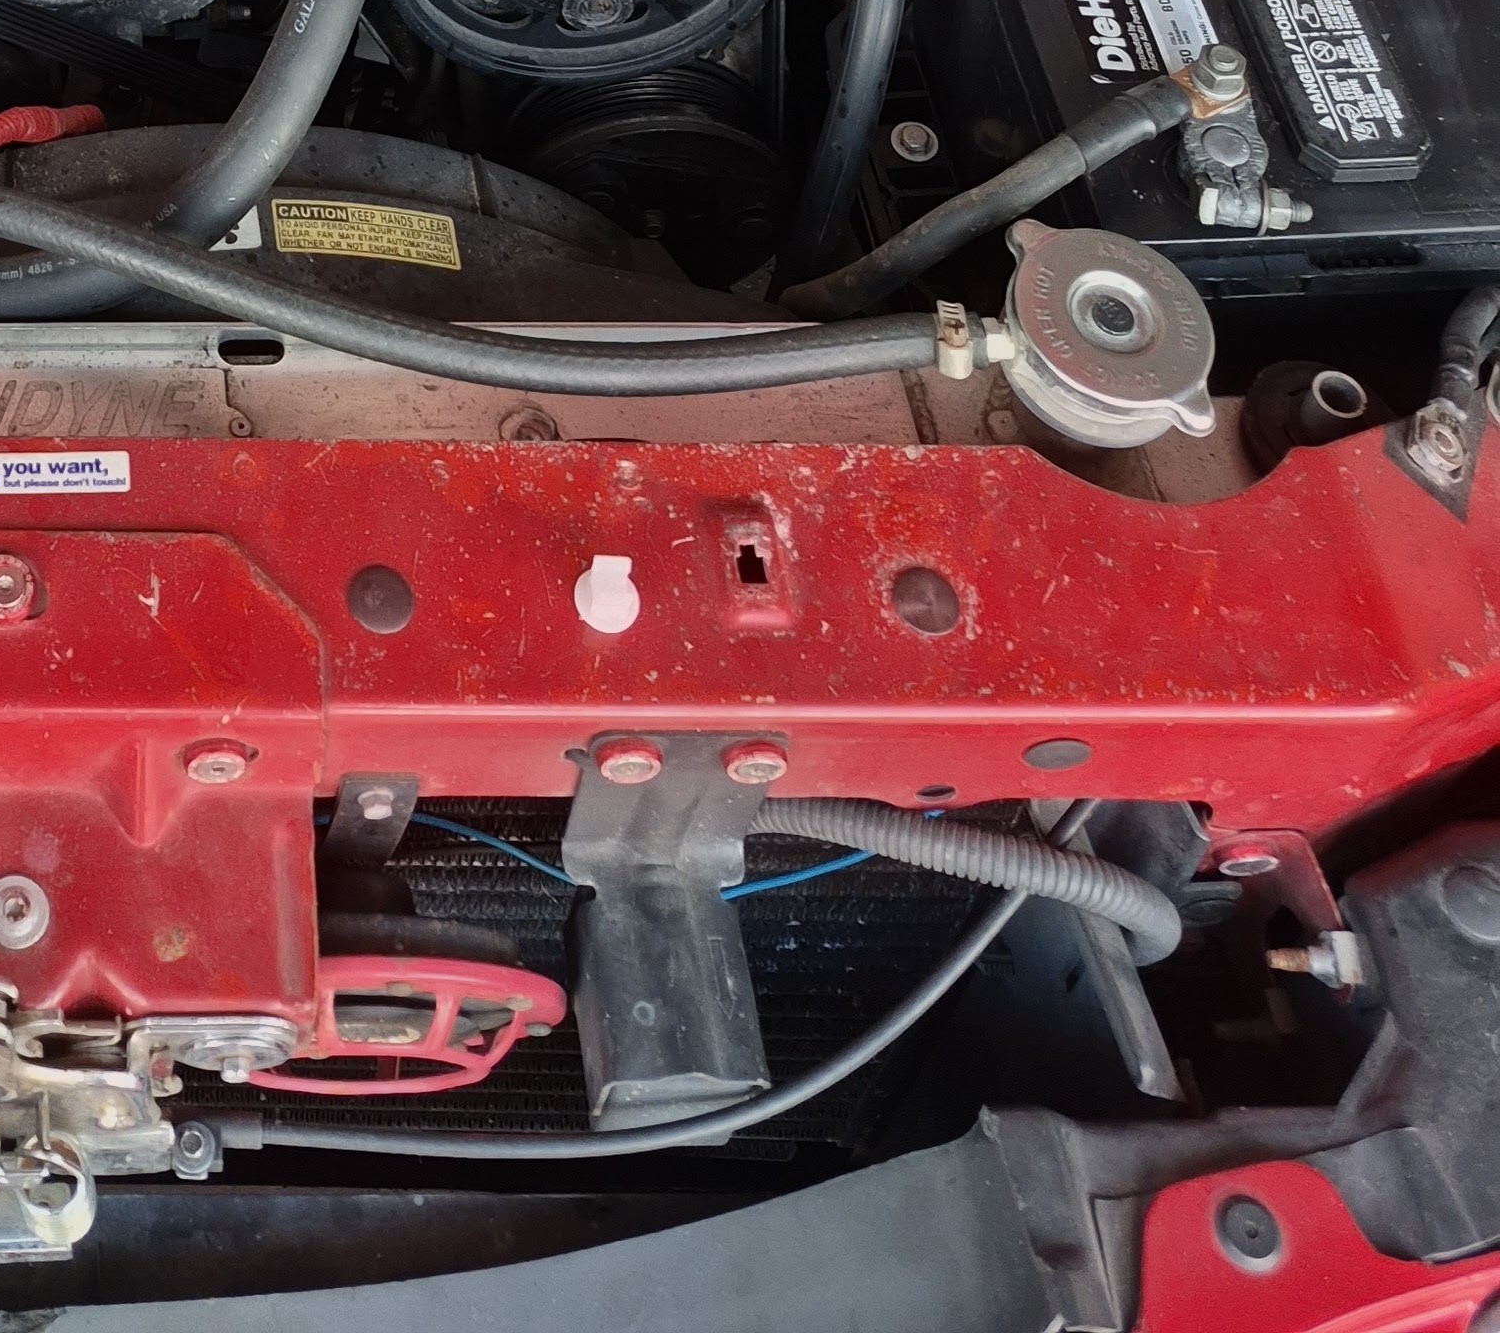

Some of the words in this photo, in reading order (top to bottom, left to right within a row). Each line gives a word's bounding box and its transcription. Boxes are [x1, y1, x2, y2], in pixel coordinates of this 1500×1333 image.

[1290, 53, 1330, 115] DANGER
[156, 202, 179, 222] USA
[278, 206, 348, 221] CAUTION
[349, 210, 376, 223] KEEP
[380, 213, 414, 228] HANDS
[417, 217, 449, 233] CLEAR
[282, 238, 325, 248] WHETHER
[329, 241, 342, 249] OR
[346, 242, 364, 251] NOT
[368, 244, 401, 256] ENGINE
[27, 261, 53, 276] 4826
[2, 460, 42, 479] you
[47, 458, 109, 477] want,
[3, 478, 21, 488] but
[24, 479, 60, 490] please
[62, 477, 90, 488] don't
[92, 476, 127, 487] touch!
